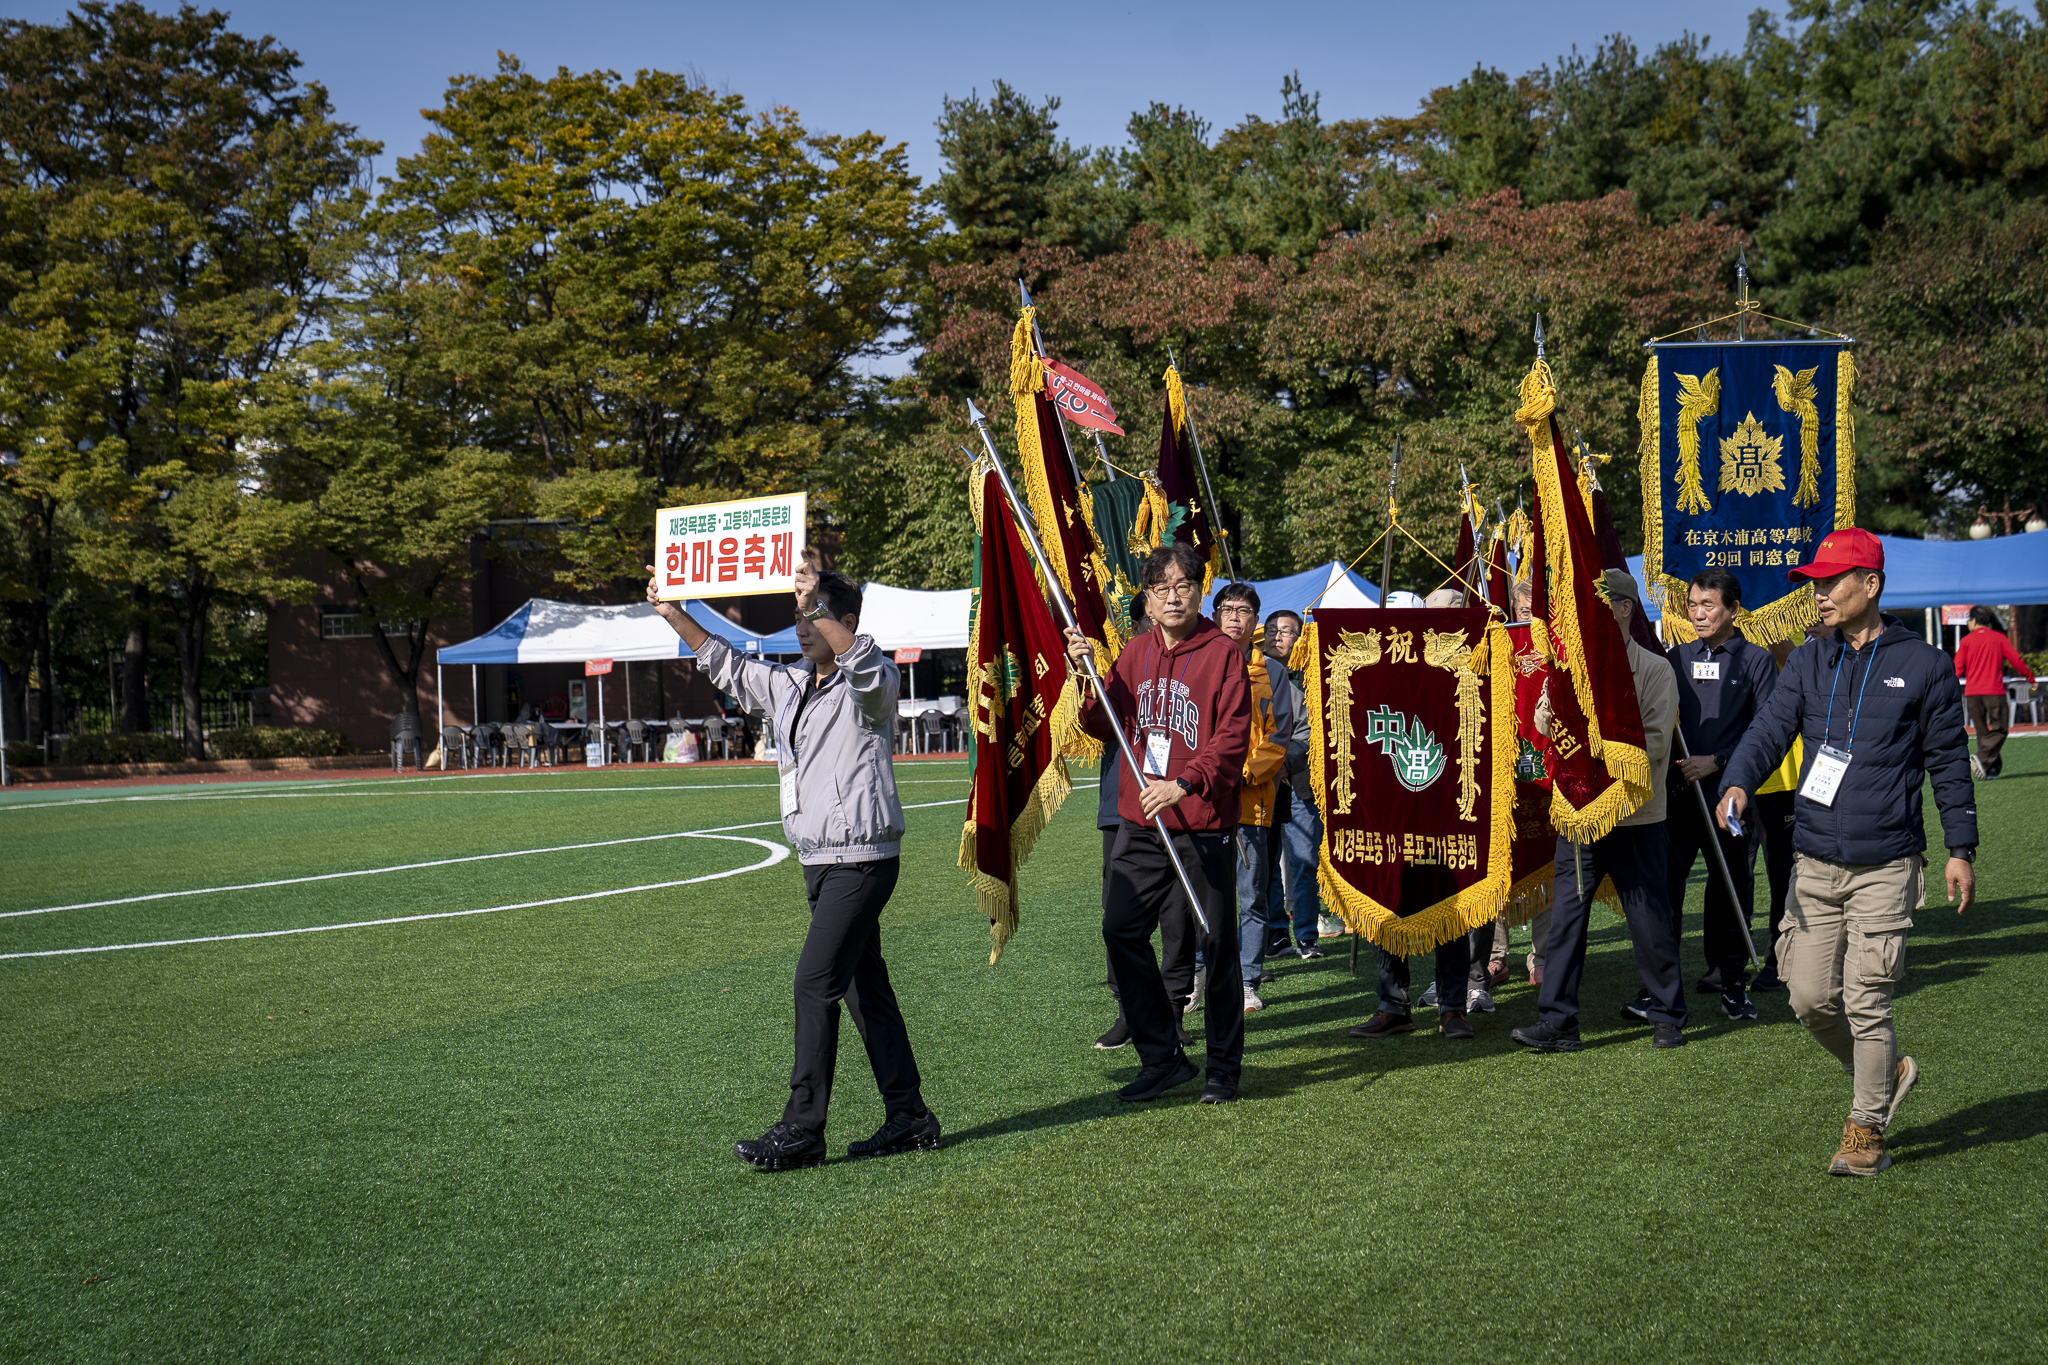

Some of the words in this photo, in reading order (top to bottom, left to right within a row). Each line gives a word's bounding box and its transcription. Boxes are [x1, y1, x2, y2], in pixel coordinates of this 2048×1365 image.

[669, 505, 791, 536] 재경목포중·고등학교동문회
[666, 531, 793, 586] 한마음축제
[1705, 550, 1742, 567] 29回
[1384, 625, 1418, 664] 祝
[1136, 679, 1152, 694] LOS
[1152, 677, 1190, 698] NELES
[1365, 704, 1405, 755] 中
[1550, 707, 1582, 760] 창회
